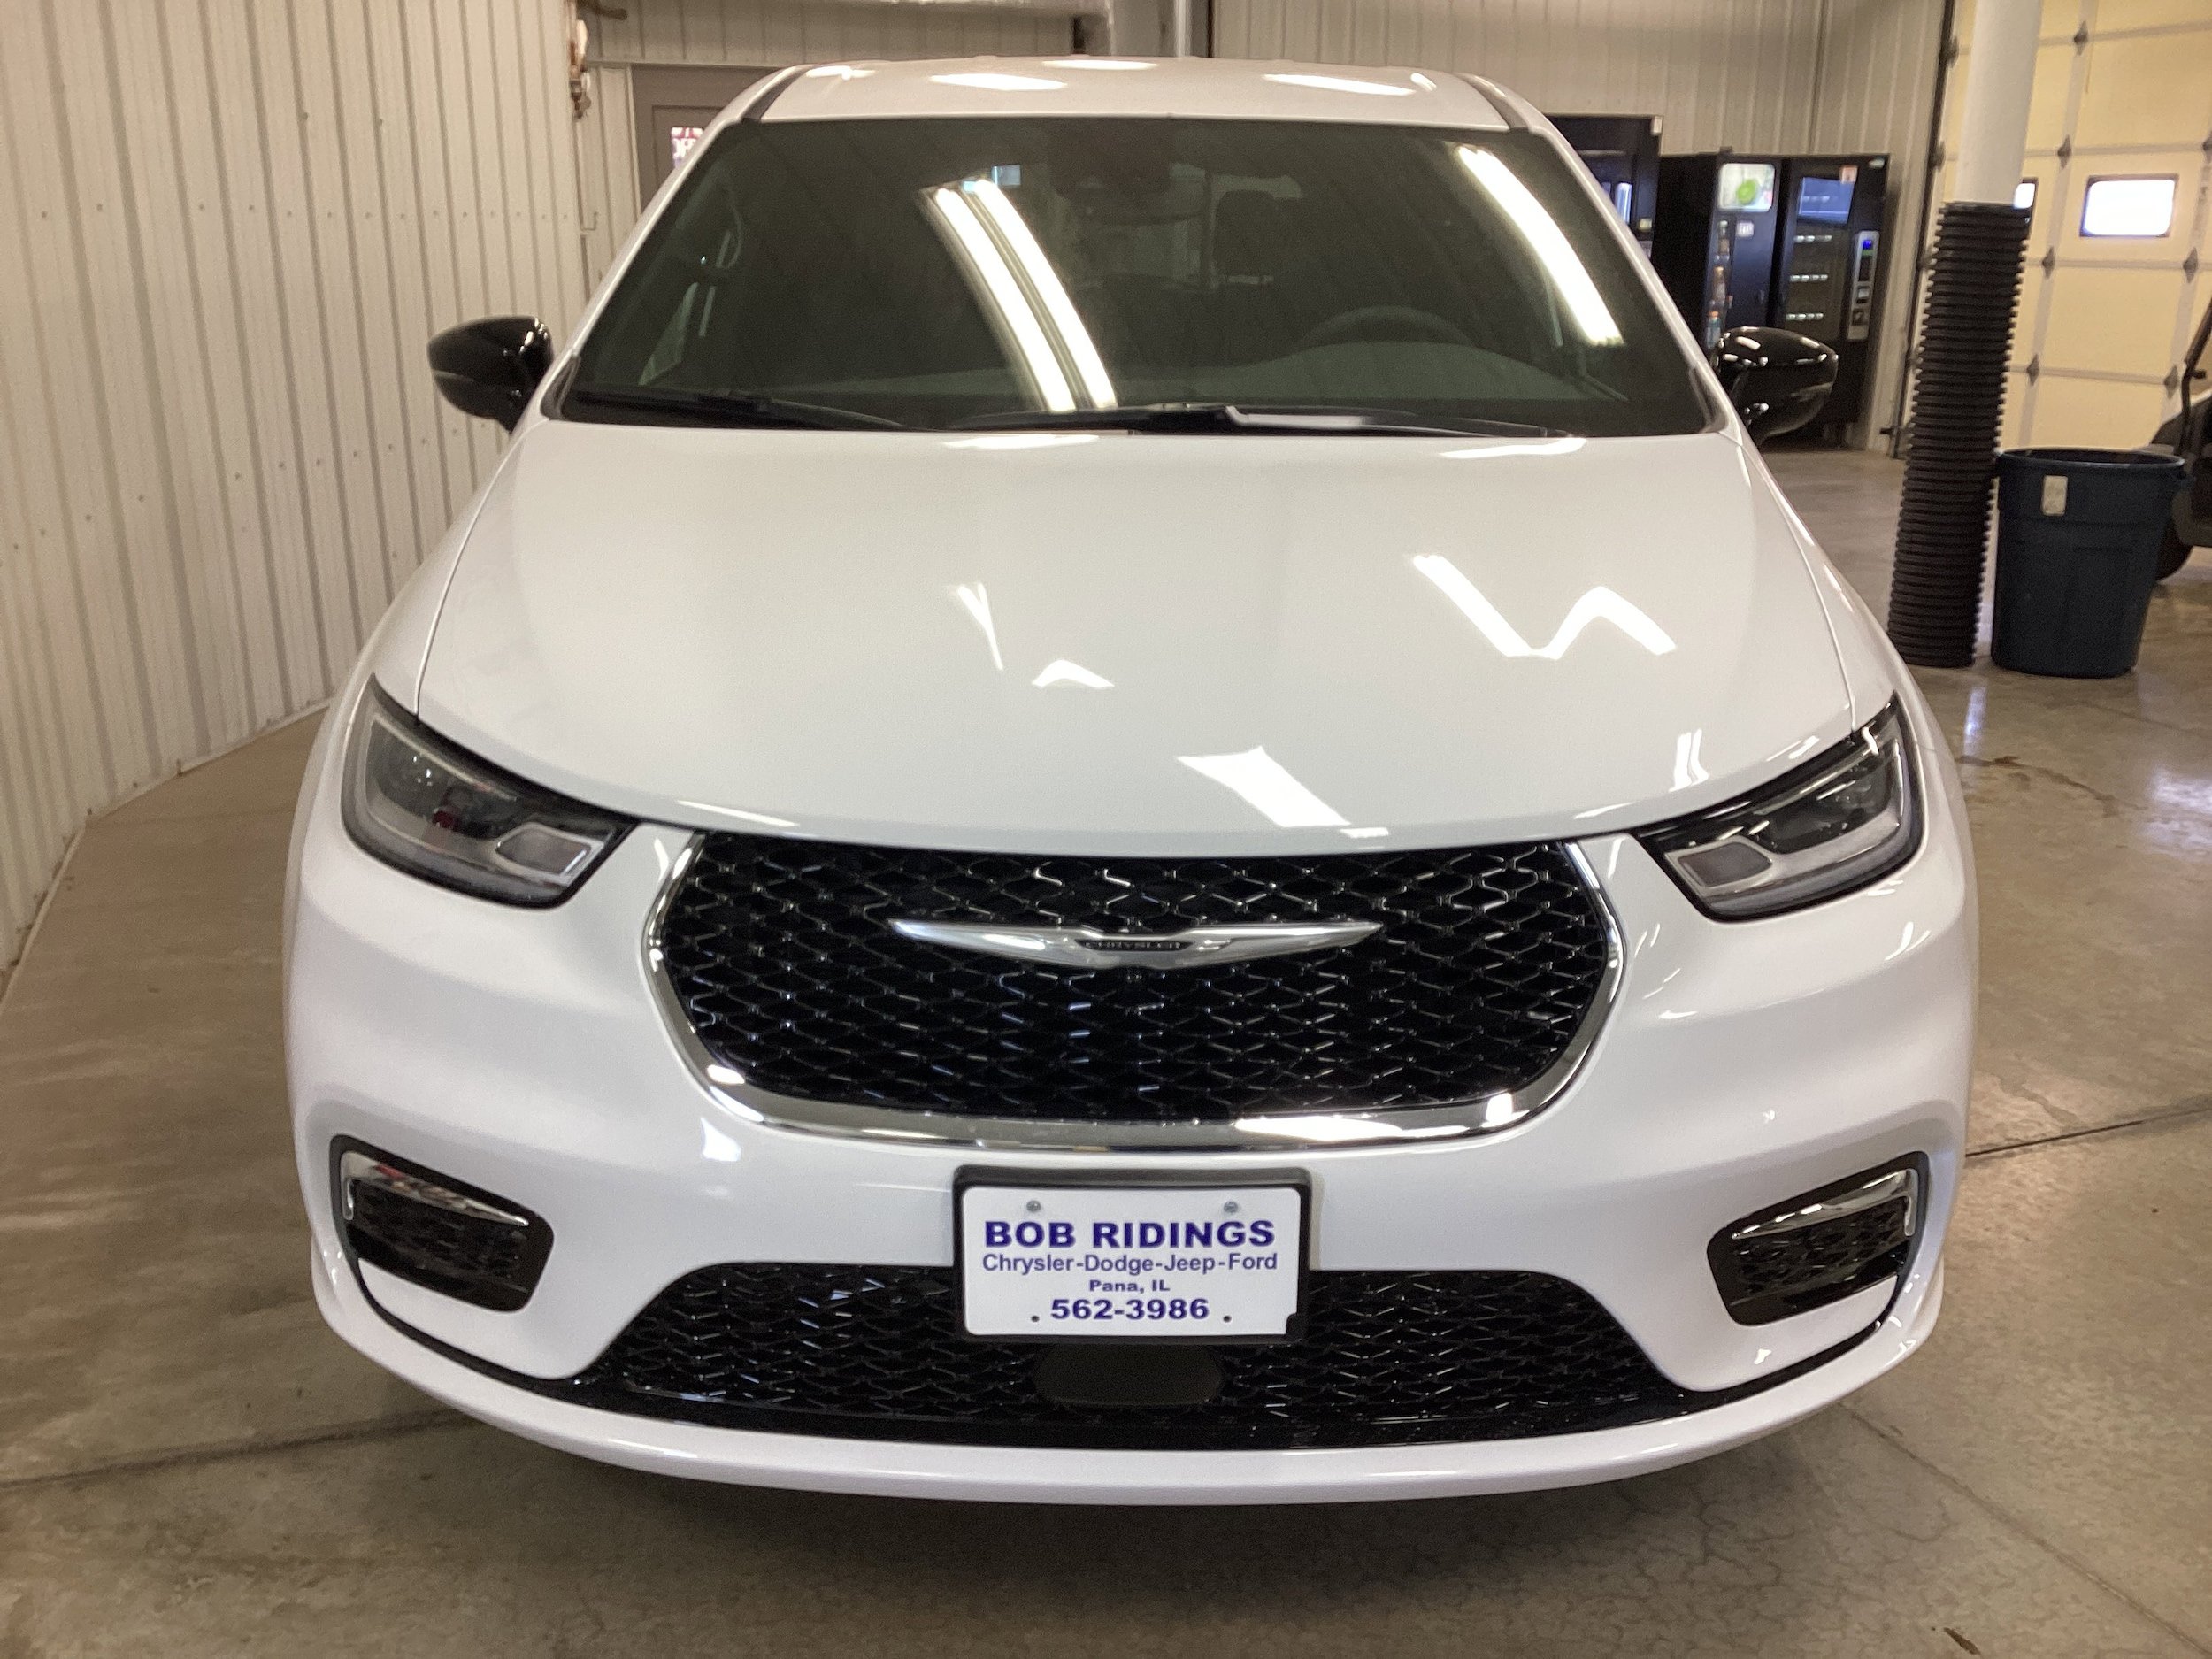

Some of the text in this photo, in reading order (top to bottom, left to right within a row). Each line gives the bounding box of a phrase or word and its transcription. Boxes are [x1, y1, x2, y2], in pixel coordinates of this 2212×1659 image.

[985, 1220, 1275, 1249] BOB RIDINGS
[982, 1252, 1278, 1277] Chrysler-Dodge-Jeep-Ford
[1089, 1279, 1171, 1294] Pana, IL
[1050, 1297, 1210, 1320] 562-3986
